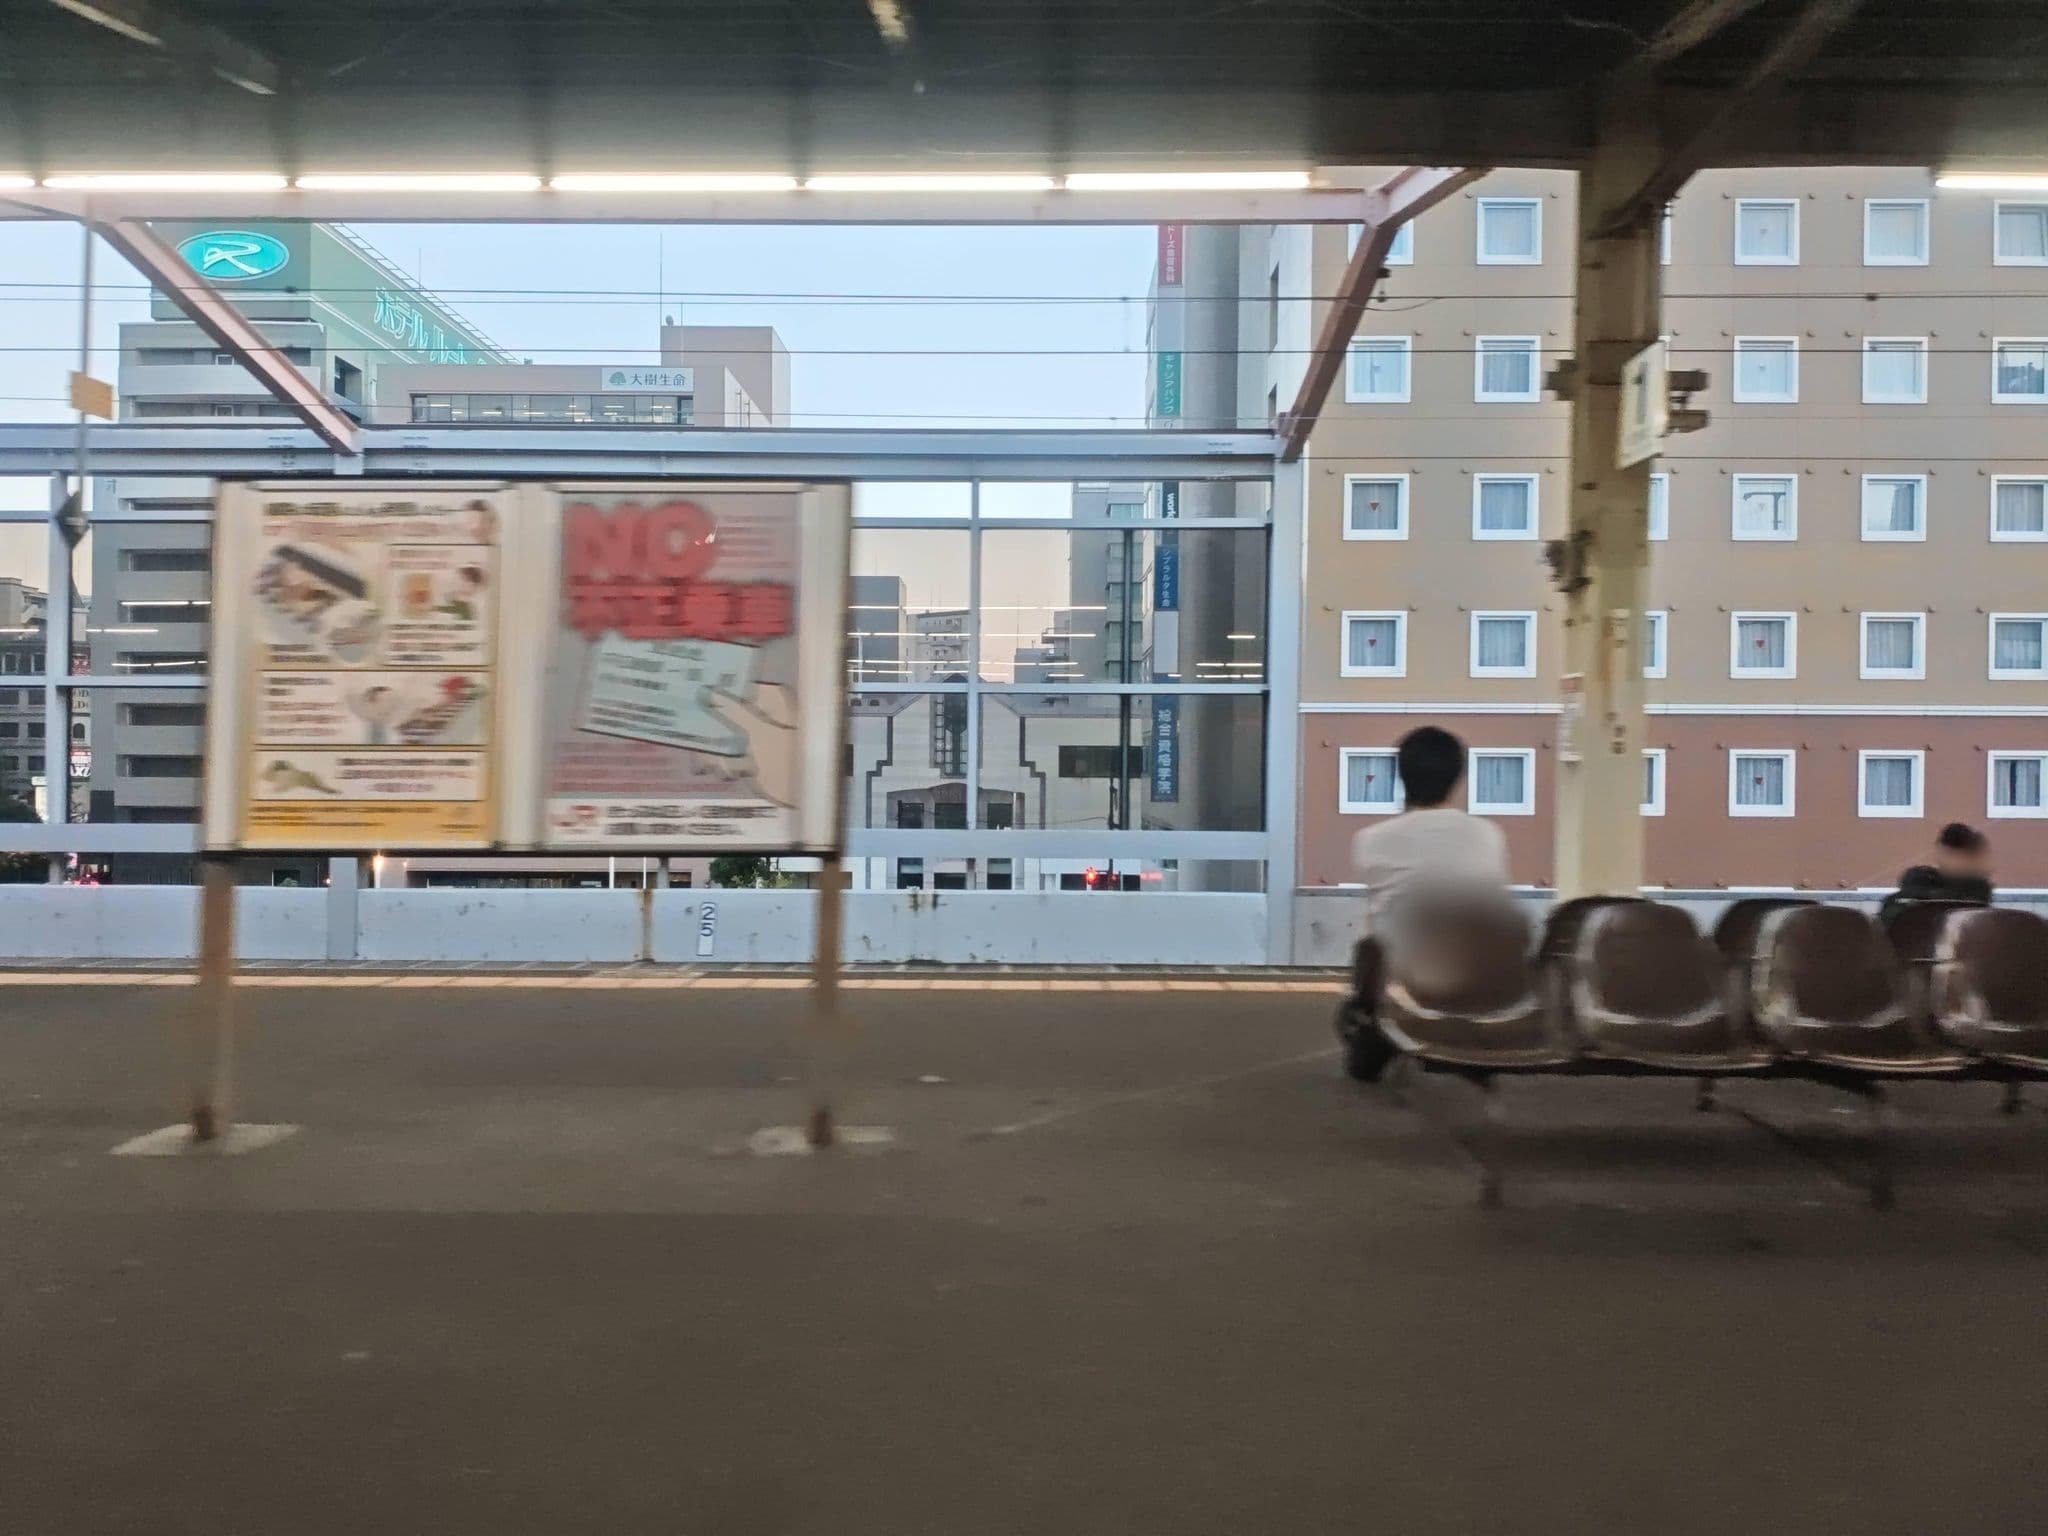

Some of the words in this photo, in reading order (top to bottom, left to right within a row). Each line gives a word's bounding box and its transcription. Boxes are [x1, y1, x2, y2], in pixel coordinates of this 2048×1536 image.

[373, 286, 428, 353] ホテル
[630, 373, 686, 386] 大樹生命
[700, 906, 716, 937] 25
